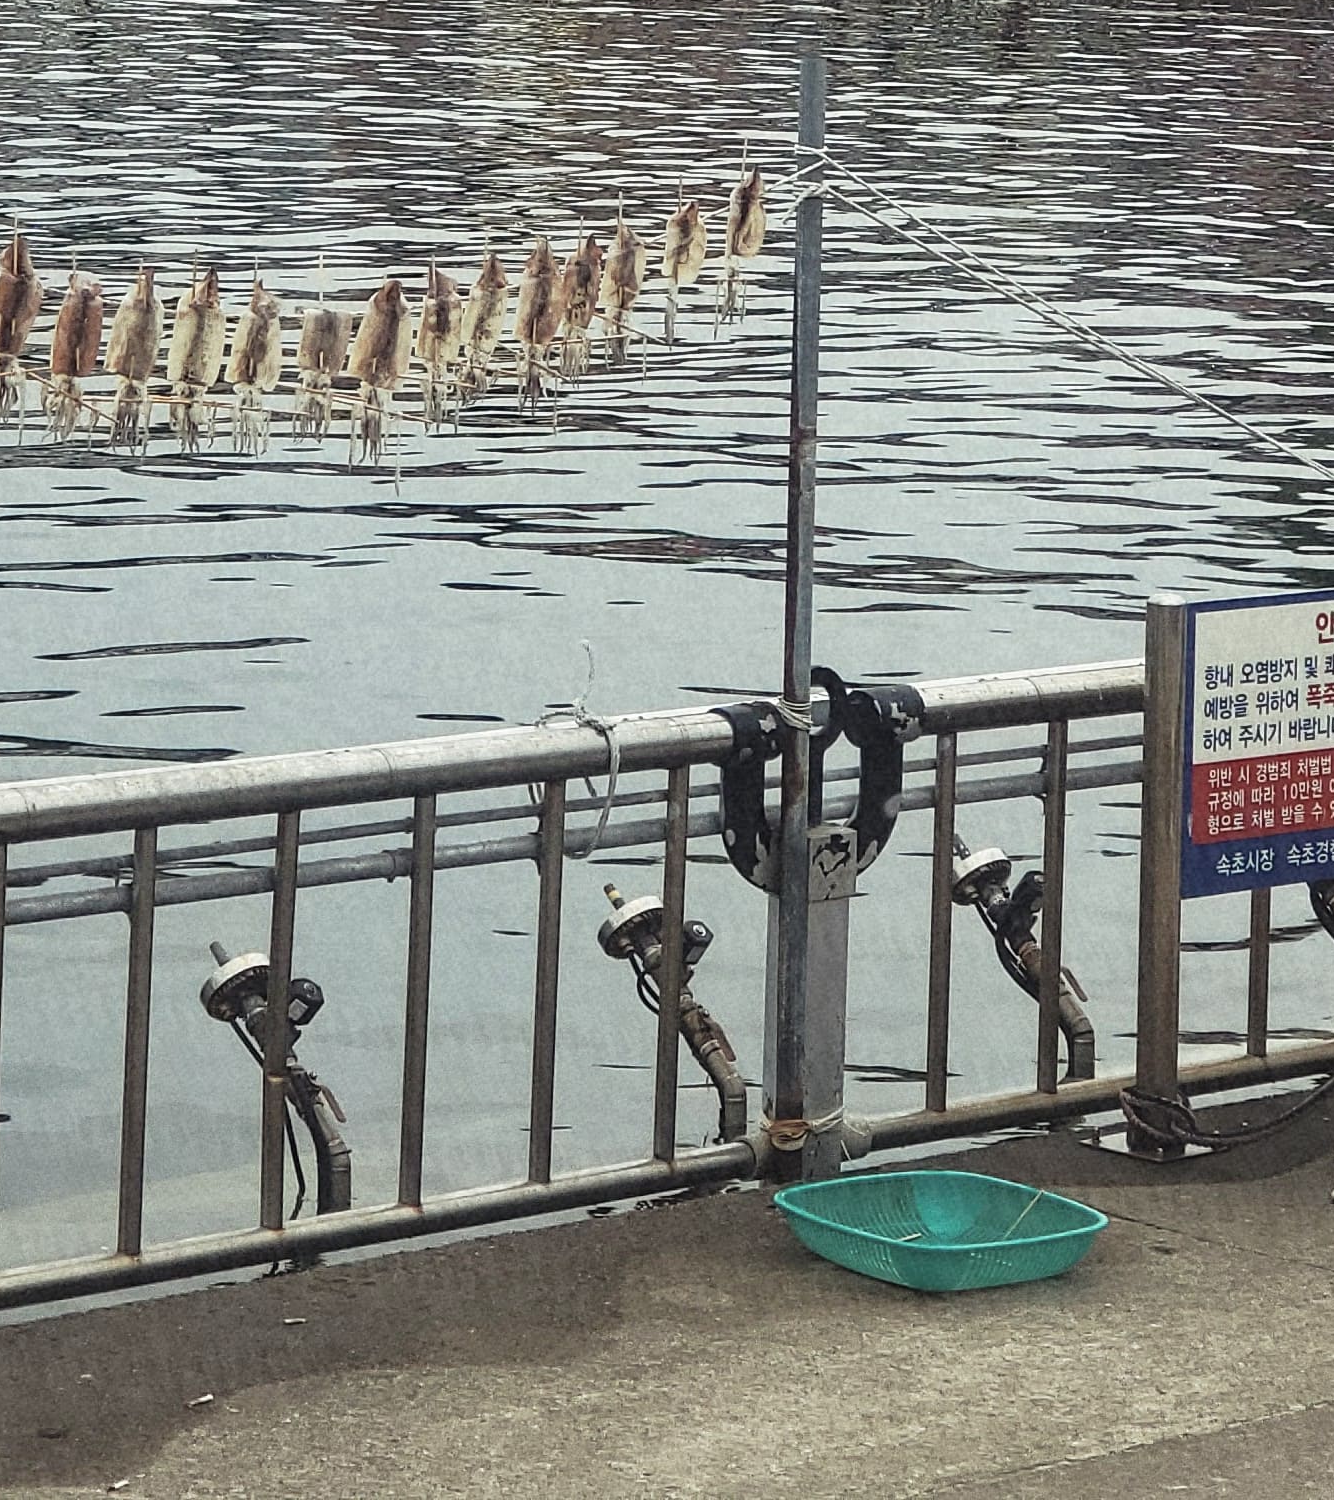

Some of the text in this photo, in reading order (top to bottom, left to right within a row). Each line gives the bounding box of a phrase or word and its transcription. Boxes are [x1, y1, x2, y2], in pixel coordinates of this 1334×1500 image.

[1204, 663, 1234, 690] 항내
[1240, 657, 1298, 685] 오염방지
[1304, 655, 1318, 679] 및
[1204, 693, 1249, 720] 예방을
[1256, 687, 1299, 715] 위하여
[1203, 726, 1232, 752] 하여
[1238, 720, 1282, 748] 주시기
[1208, 766, 1232, 788] 위반
[1238, 764, 1250, 785] 시
[1256, 760, 1291, 783] 경범죄
[1297, 755, 1332, 777] 처벌법
[1208, 789, 1244, 812] 규정에
[1251, 785, 1275, 806] 따라
[1282, 778, 1323, 800] 10만원
[1208, 812, 1245, 835] 형으로
[1251, 807, 1275, 829] 처벌
[1281, 804, 1305, 825] 받을
[1311, 801, 1323, 821] 수
[1216, 847, 1275, 877] 속초시장
